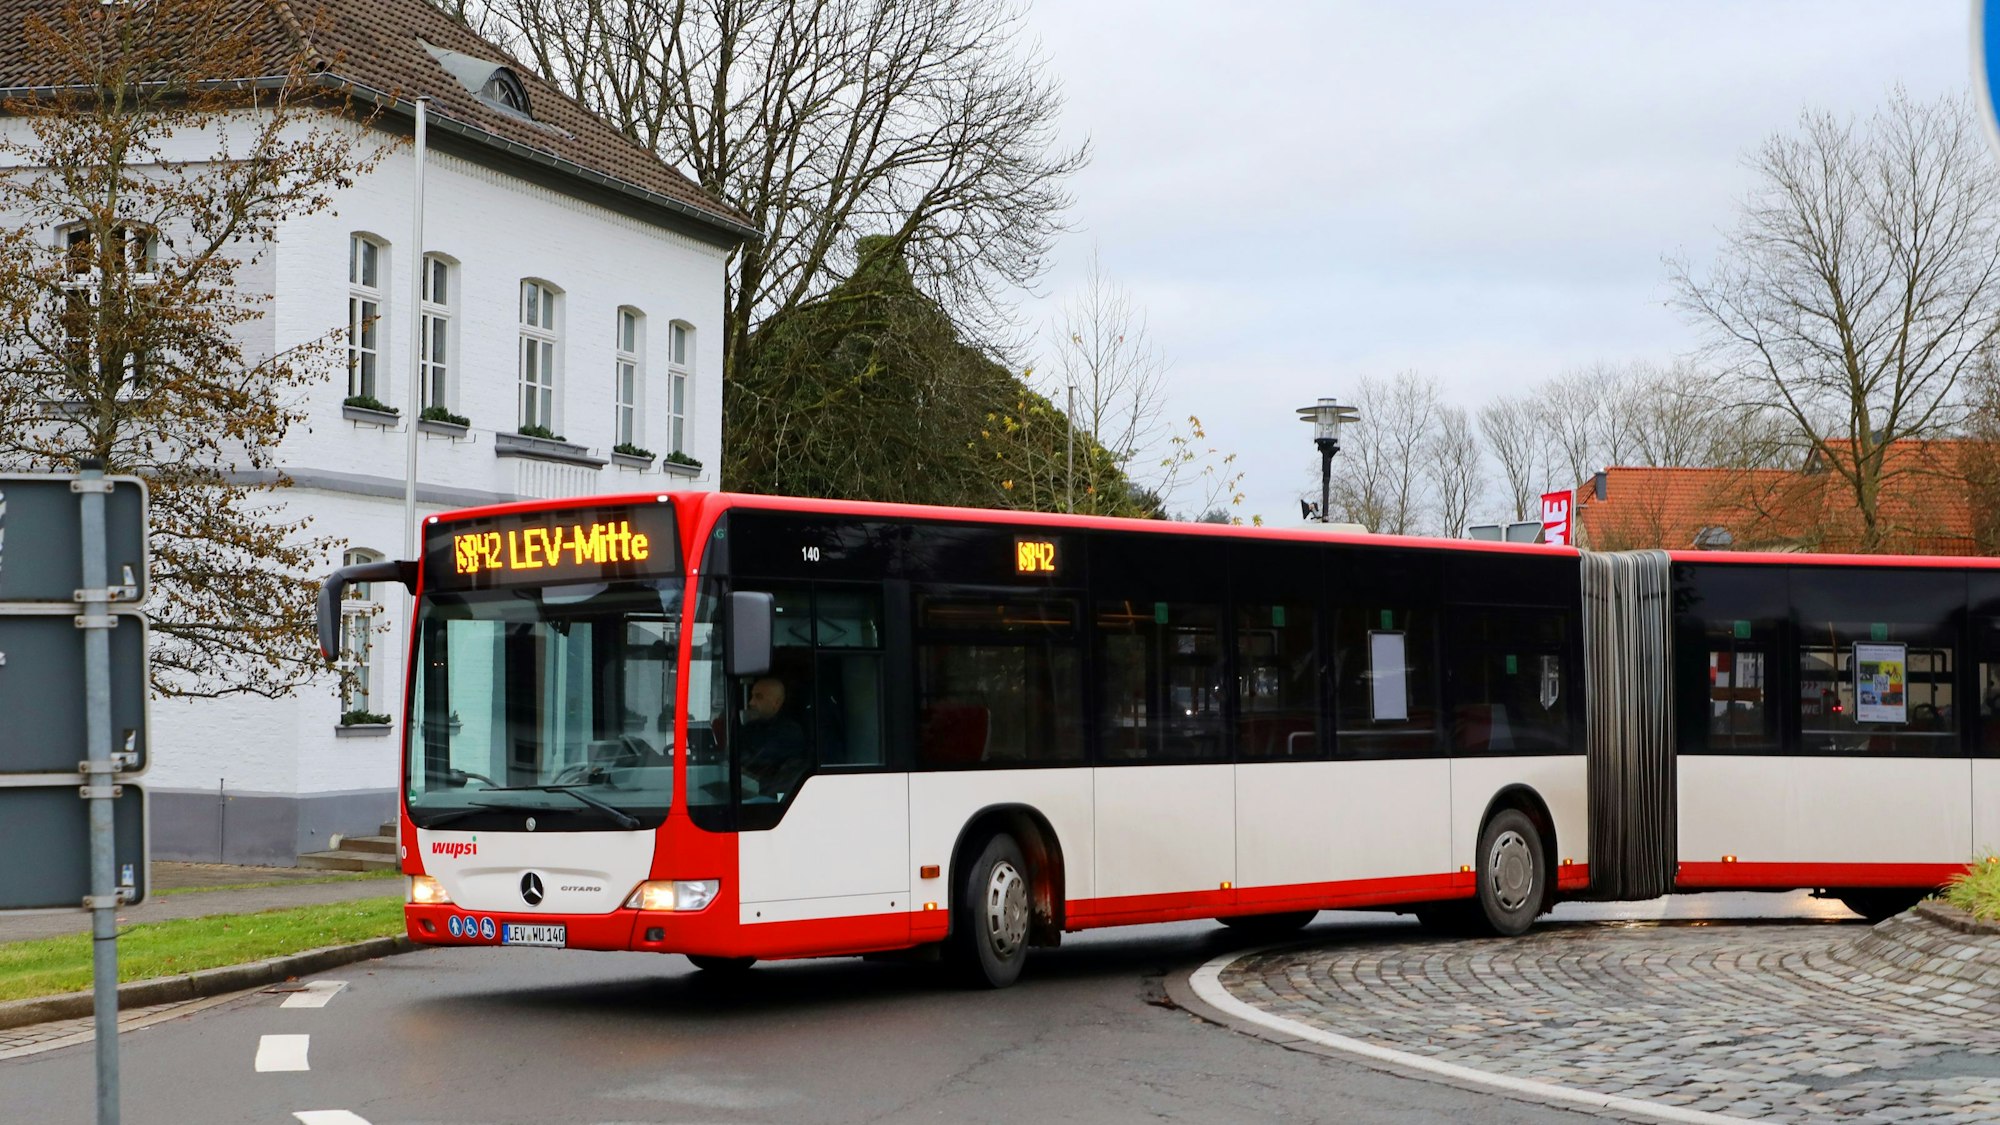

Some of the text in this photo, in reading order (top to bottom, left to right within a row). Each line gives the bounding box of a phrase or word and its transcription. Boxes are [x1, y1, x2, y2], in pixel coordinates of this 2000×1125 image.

[508, 521, 649, 570] LEV-Mitte
[801, 546, 820, 562] 140
[432, 835, 477, 859] wupsi
[508, 926, 564, 943] LEV WU 140
